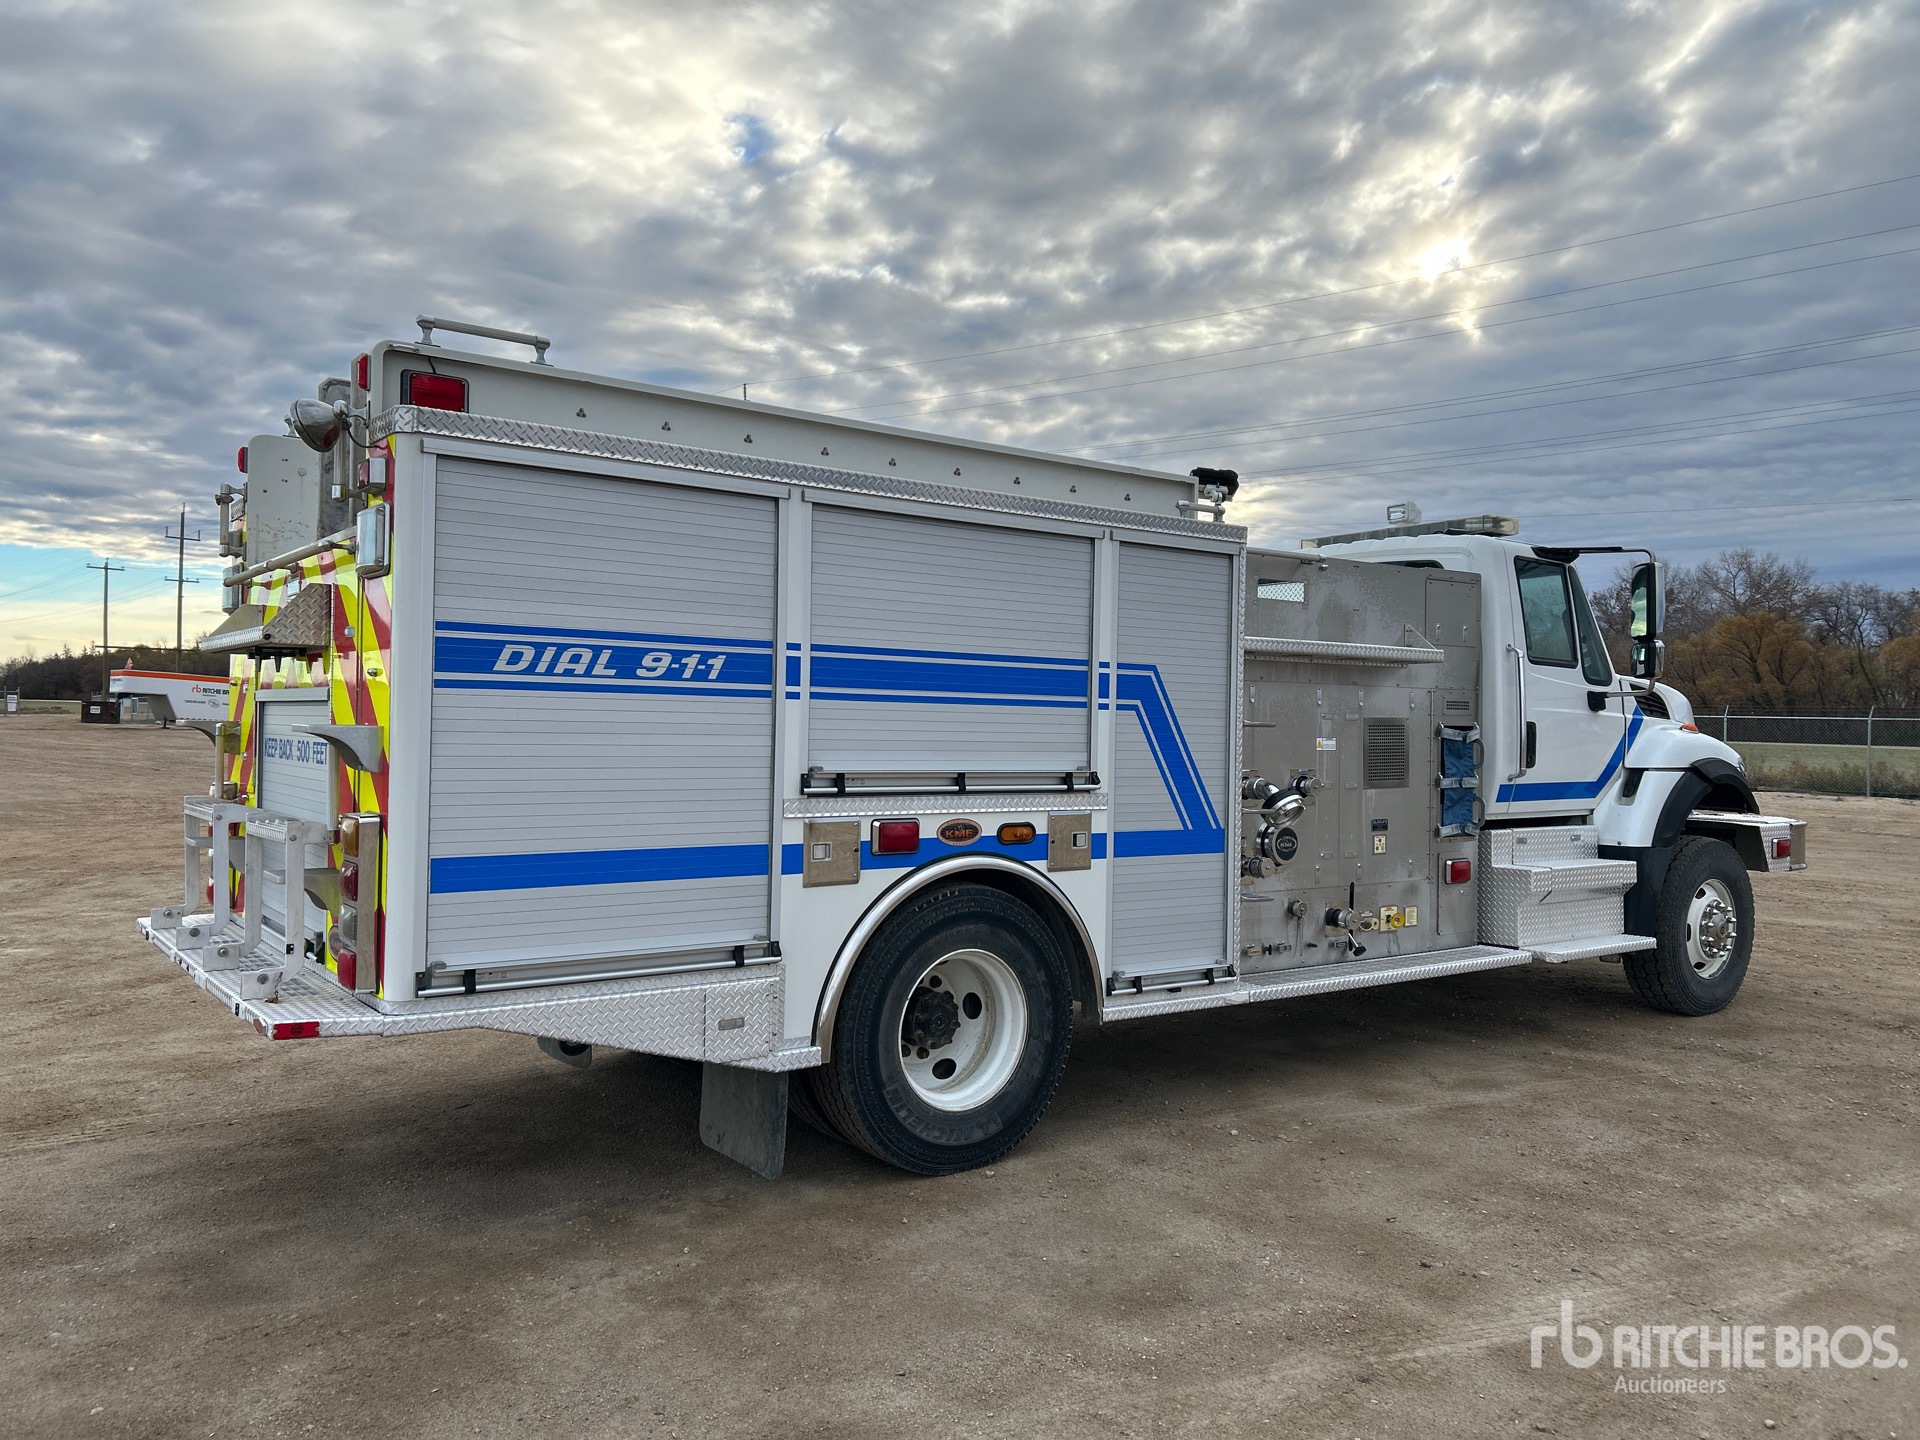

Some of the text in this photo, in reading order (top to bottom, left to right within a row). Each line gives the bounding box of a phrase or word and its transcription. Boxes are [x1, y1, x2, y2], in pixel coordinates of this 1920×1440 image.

[492, 644, 727, 680] DIAL 9-1-1
[265, 737, 327, 765] KEEP BACK 500 FEET
[945, 829, 974, 839] KME
